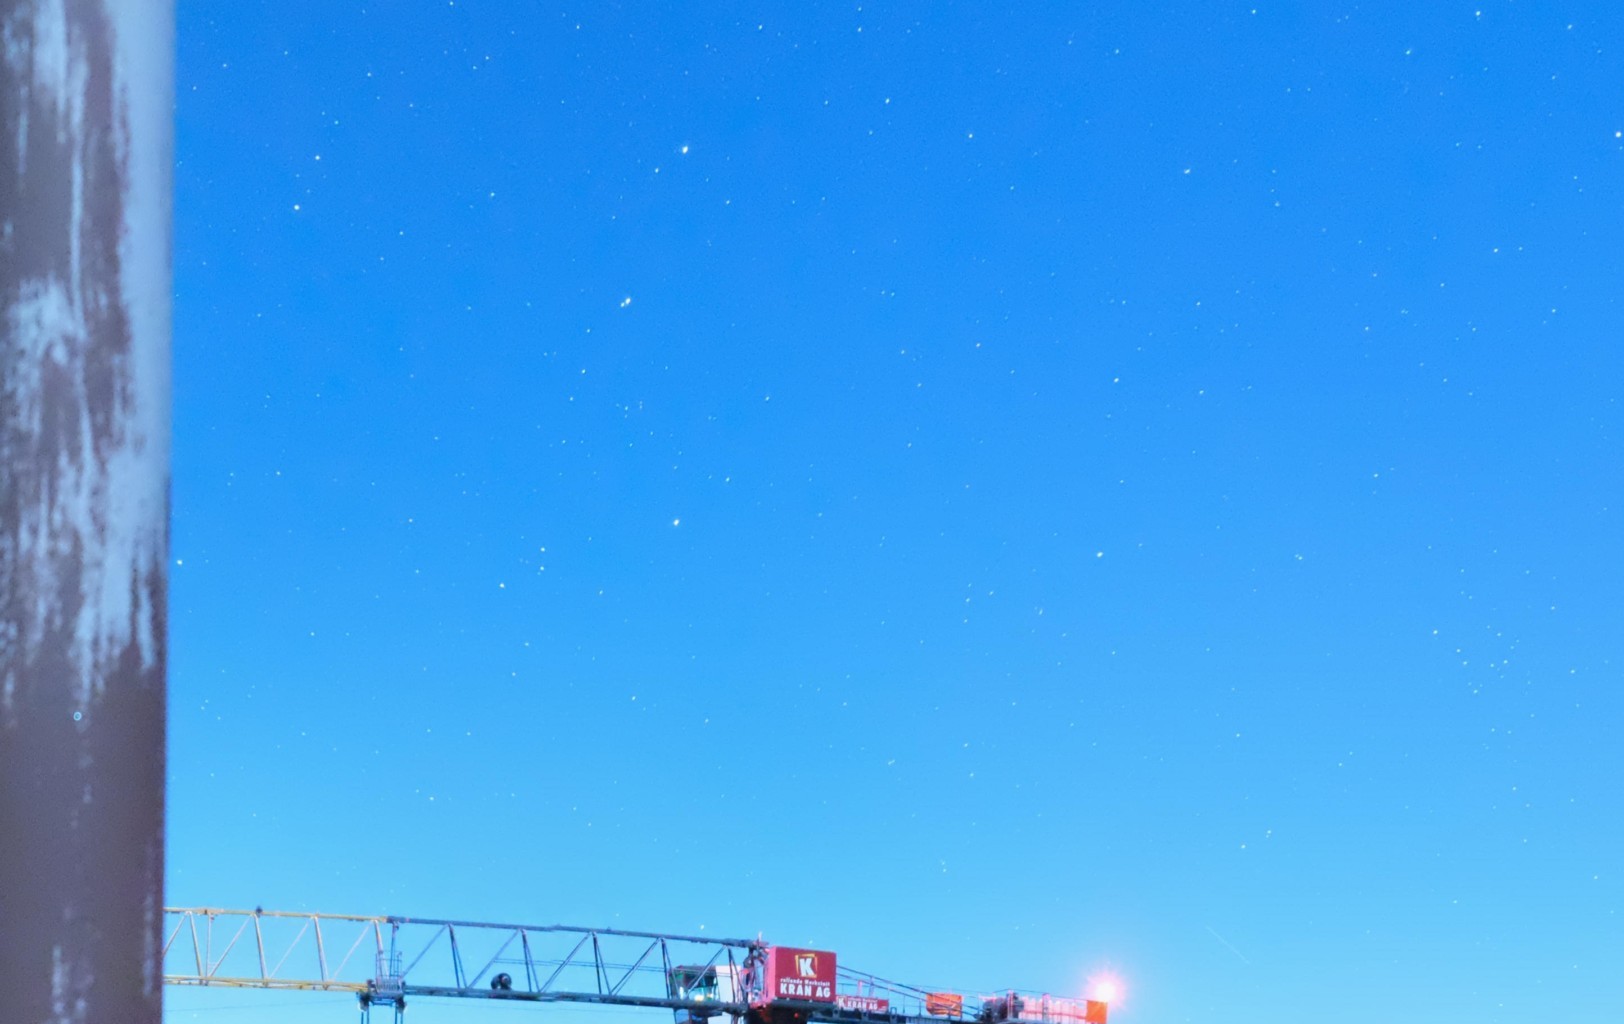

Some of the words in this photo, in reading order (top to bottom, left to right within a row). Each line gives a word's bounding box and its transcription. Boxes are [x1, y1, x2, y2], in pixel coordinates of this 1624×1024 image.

[799, 957, 815, 977] K
[780, 983, 812, 996] KRAN
[815, 986, 831, 998] AG
